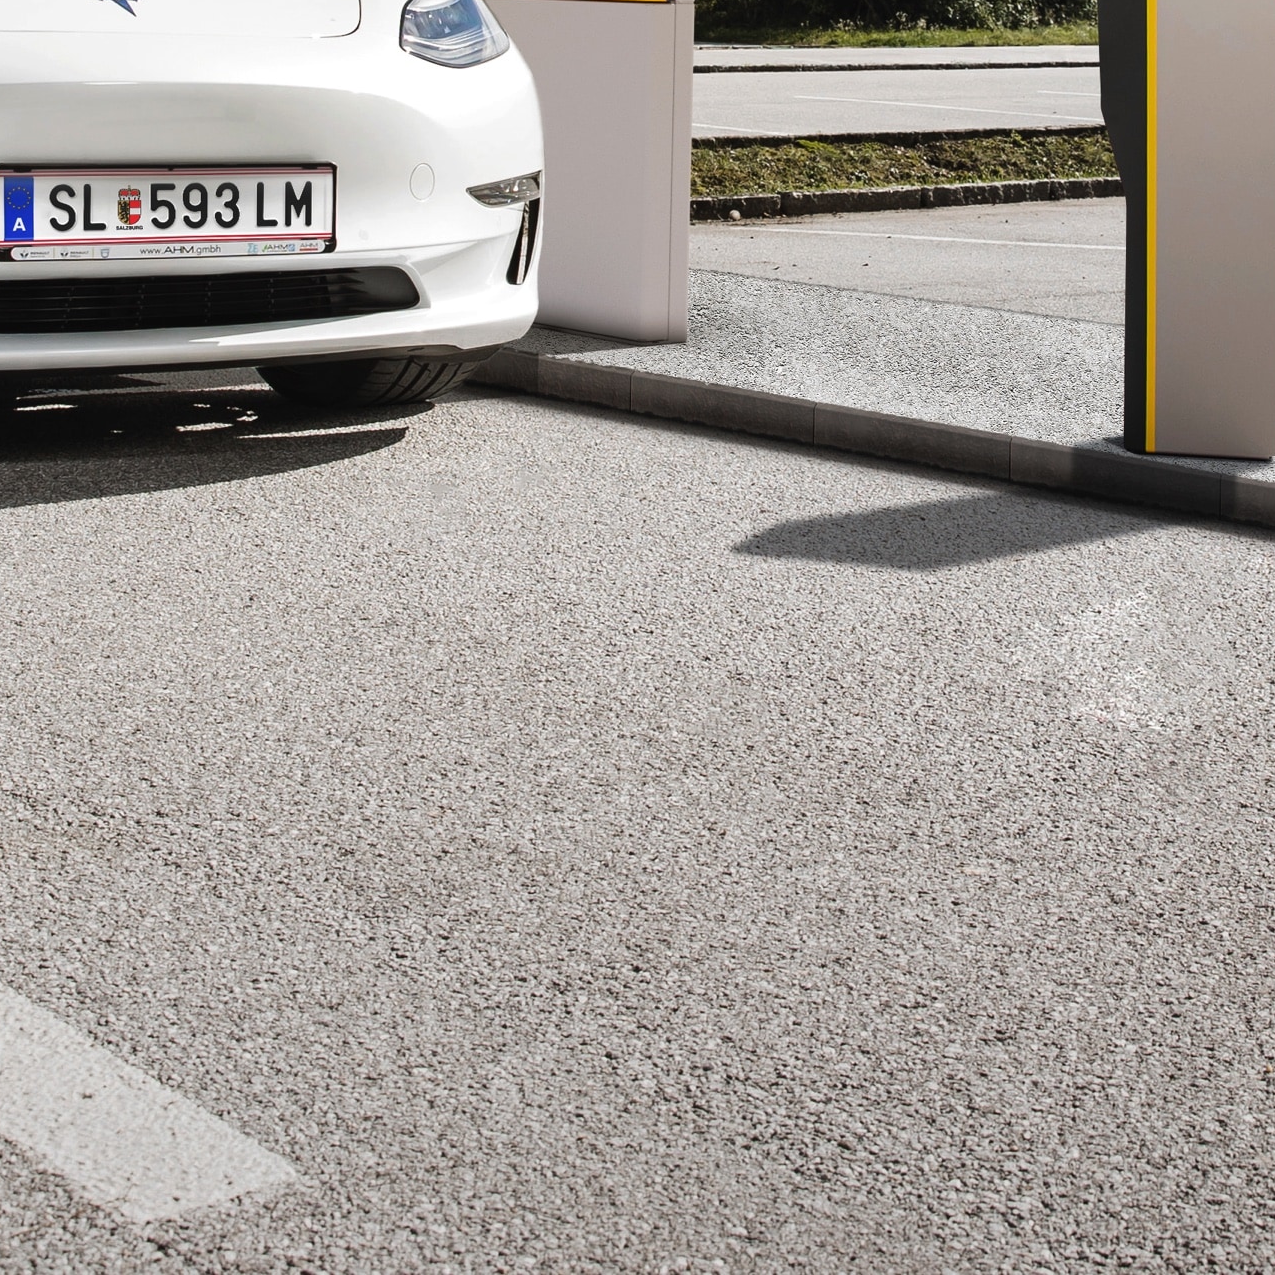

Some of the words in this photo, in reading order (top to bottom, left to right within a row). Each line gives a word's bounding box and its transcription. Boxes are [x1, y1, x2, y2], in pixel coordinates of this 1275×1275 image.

[49, 184, 107, 231] SL
[150, 182, 240, 229] 593
[256, 181, 313, 227] LM
[12, 217, 26, 231] A
[139, 244, 221, 255] www.AHM.gmbh
